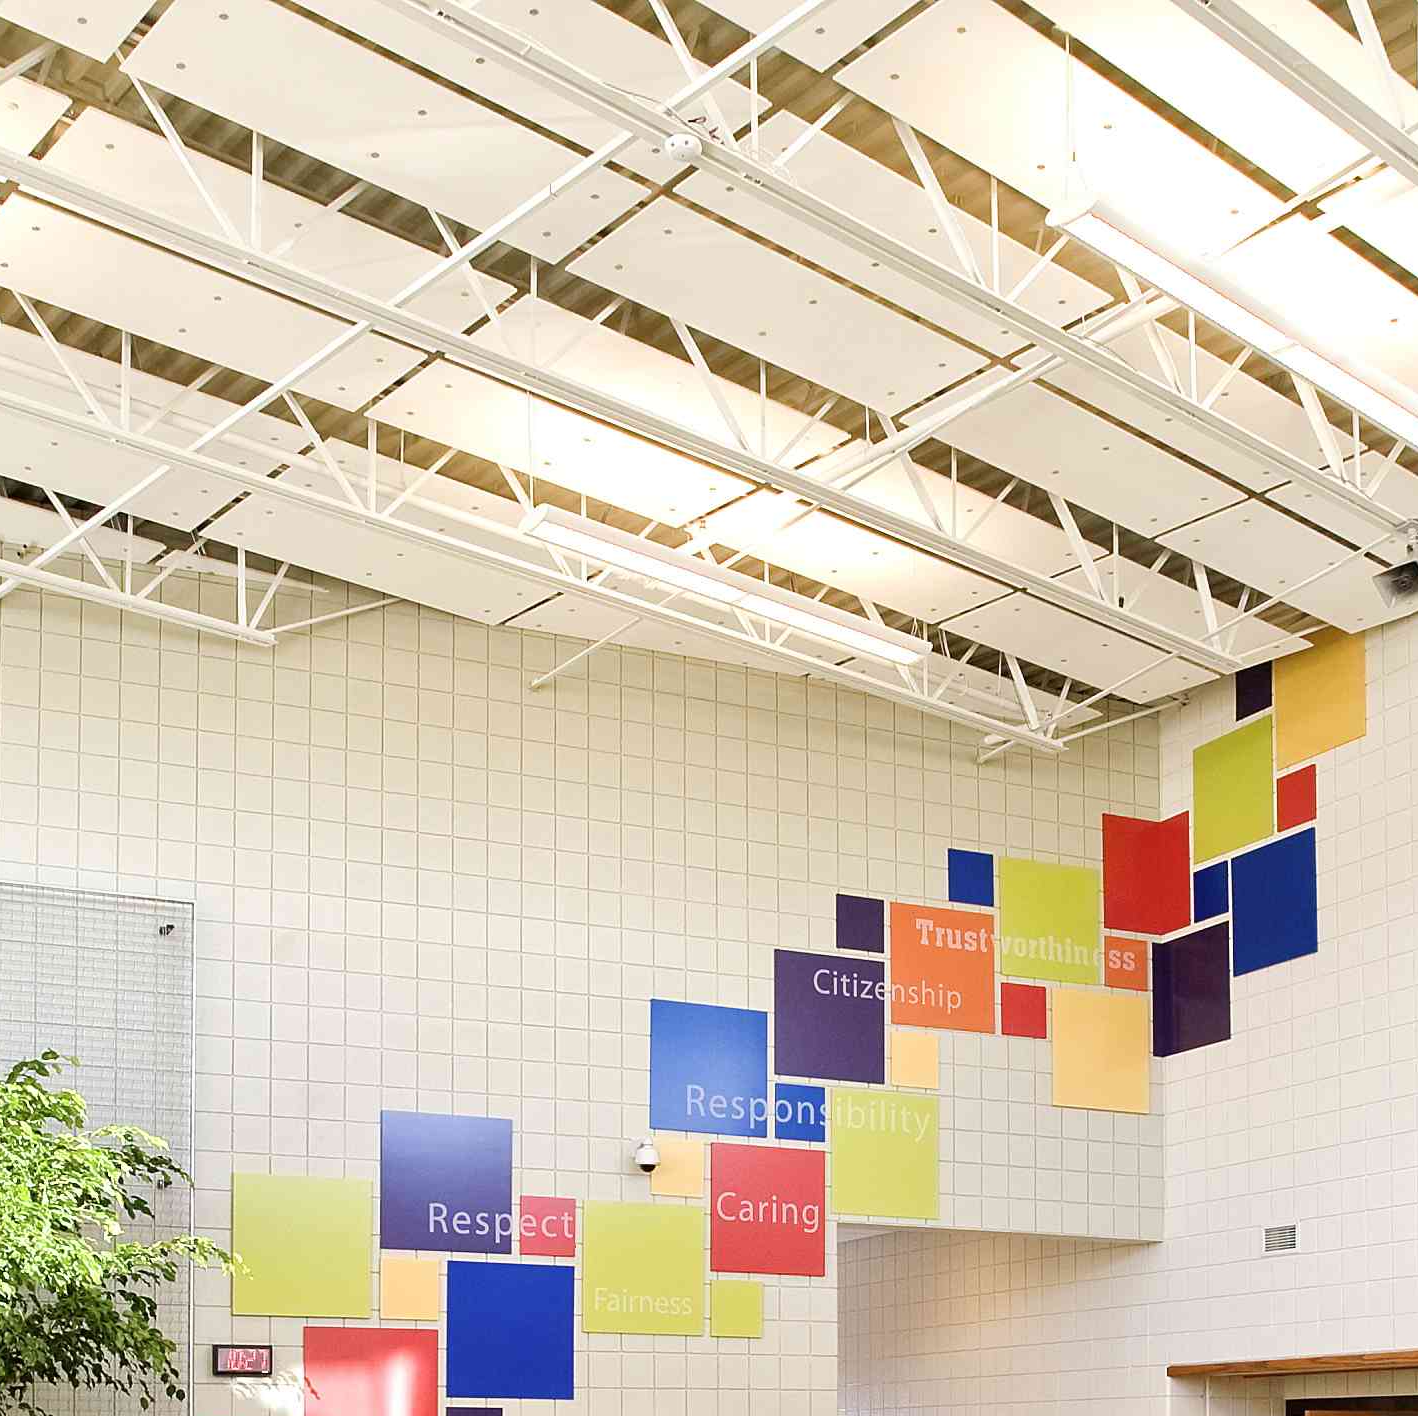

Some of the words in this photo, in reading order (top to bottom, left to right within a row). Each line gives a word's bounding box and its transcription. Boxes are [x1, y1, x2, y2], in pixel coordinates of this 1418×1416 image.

[812, 968, 962, 1014] Citizenship
[685, 1083, 931, 1143] Responsibility
[427, 1202, 574, 1244] Respect
[715, 1191, 820, 1234] Caring
[593, 1286, 693, 1316] Fairness
